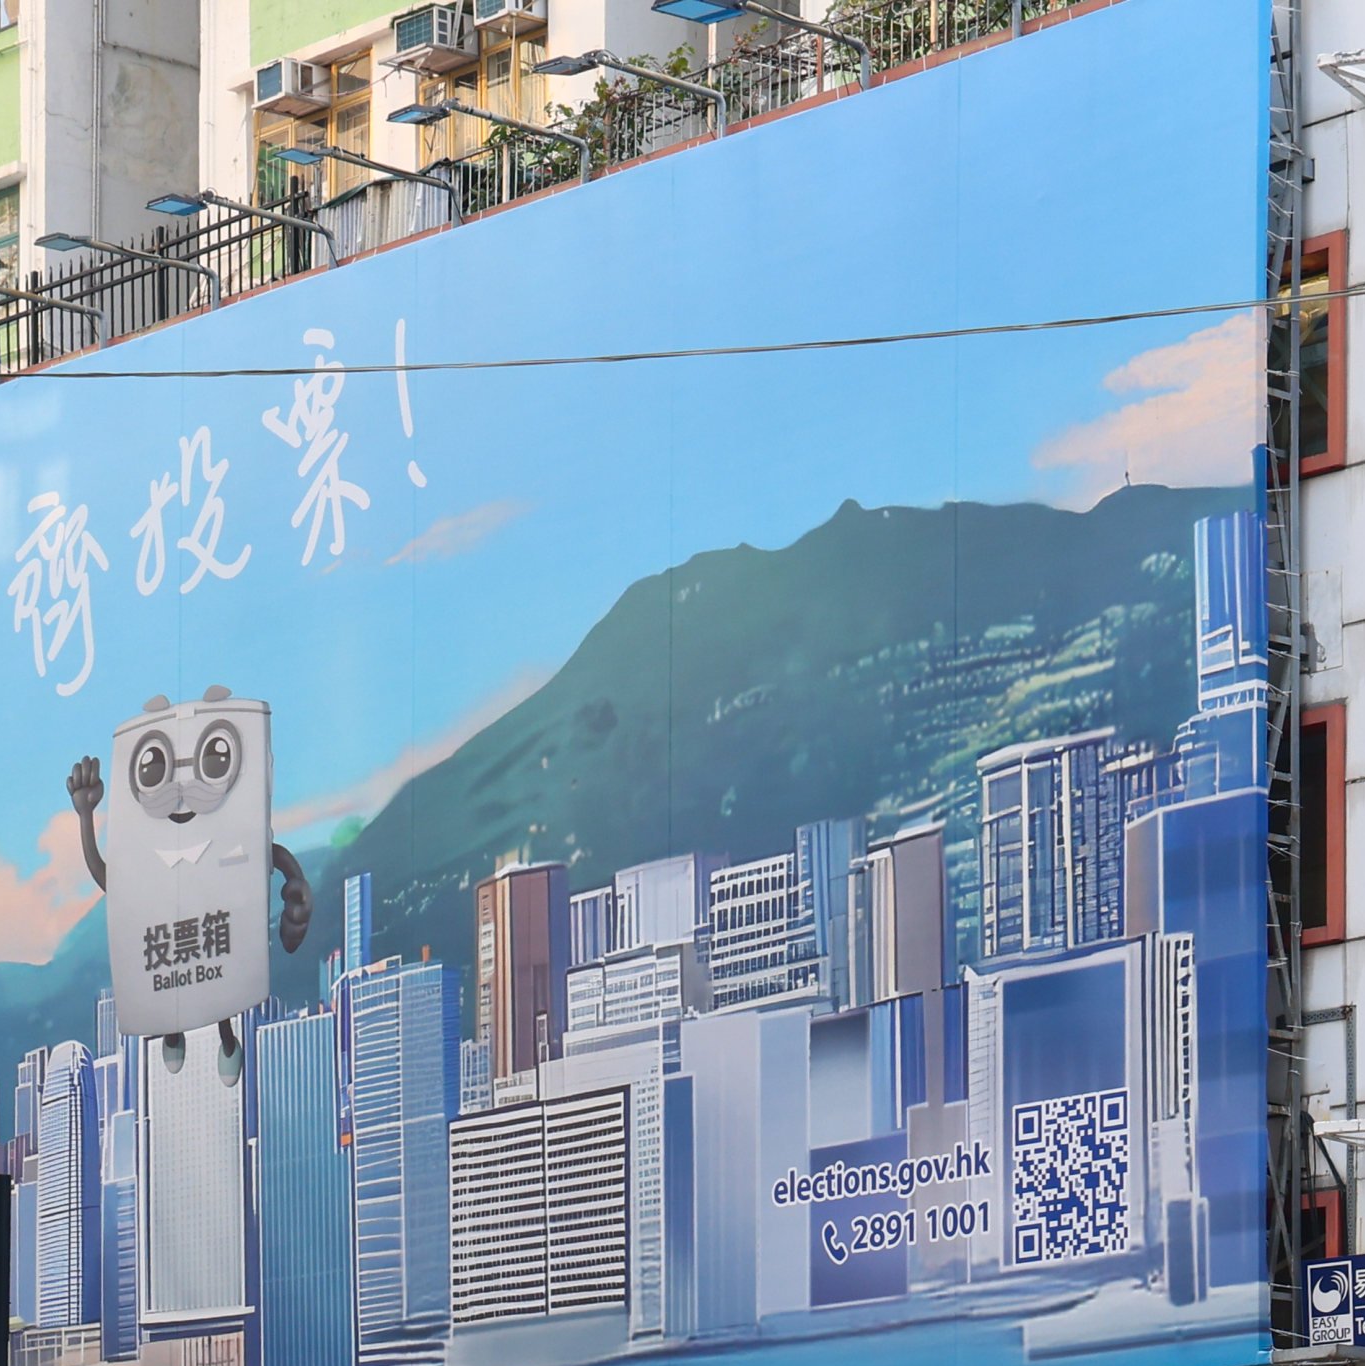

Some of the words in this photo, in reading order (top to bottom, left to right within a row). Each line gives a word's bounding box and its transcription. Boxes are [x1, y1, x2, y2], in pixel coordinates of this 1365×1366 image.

[143, 909, 231, 972] 投票箱
[153, 968, 193, 992] Ballot
[195, 965, 223, 983] Box
[772, 1140, 992, 1206] elections.gov.hk
[851, 1211, 917, 1253] 2891
[924, 1201, 991, 1241] 1001
[1312, 1316, 1339, 1330] EASY
[1312, 1327, 1351, 1342] GROUP
